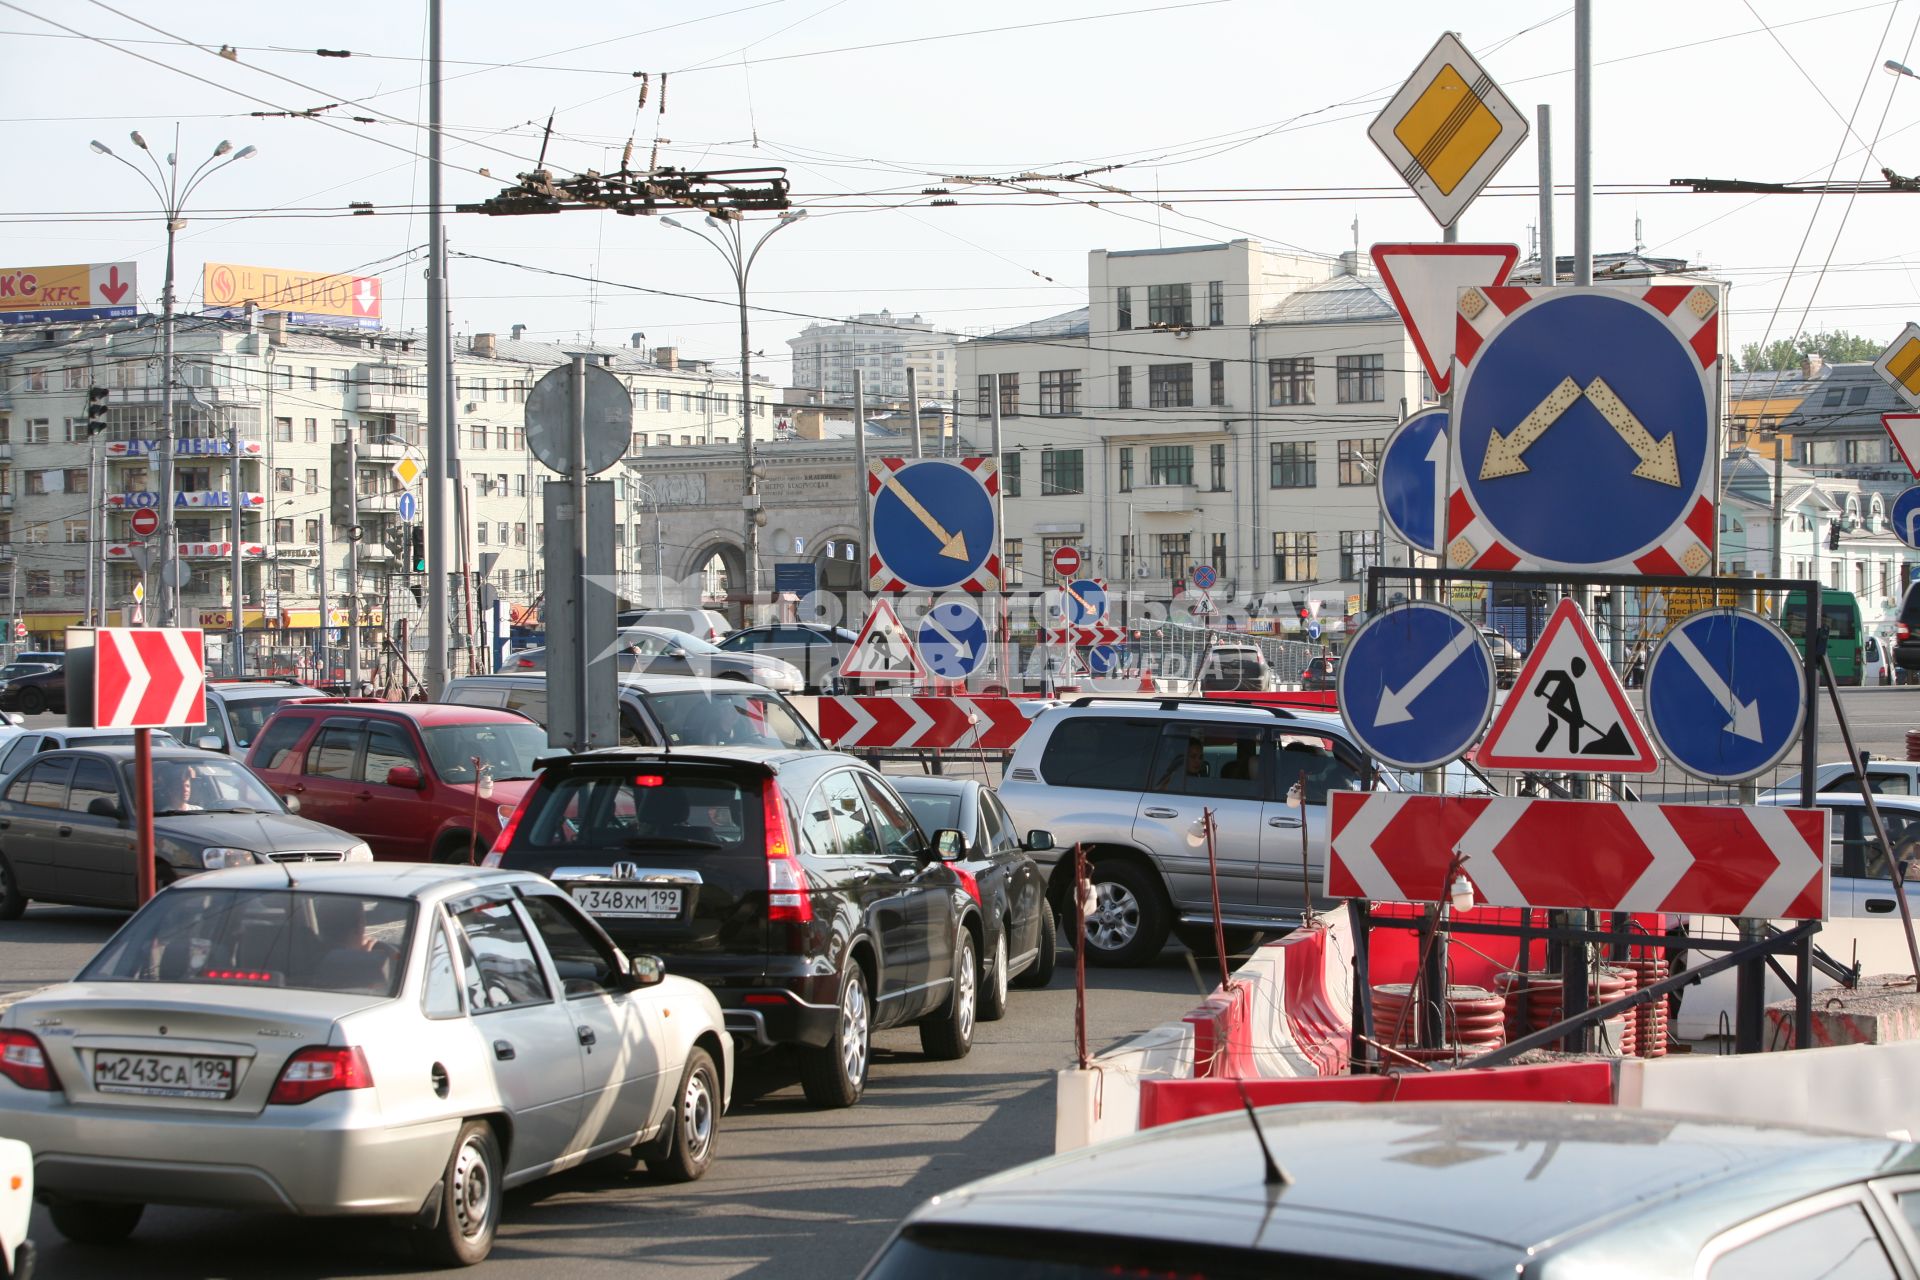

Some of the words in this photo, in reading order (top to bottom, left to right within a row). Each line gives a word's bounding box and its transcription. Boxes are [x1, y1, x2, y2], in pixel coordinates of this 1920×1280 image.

[41, 286, 82, 302] KFC
[263, 274, 348, 309] ПАТИО
[204, 491, 251, 506] МЕА
